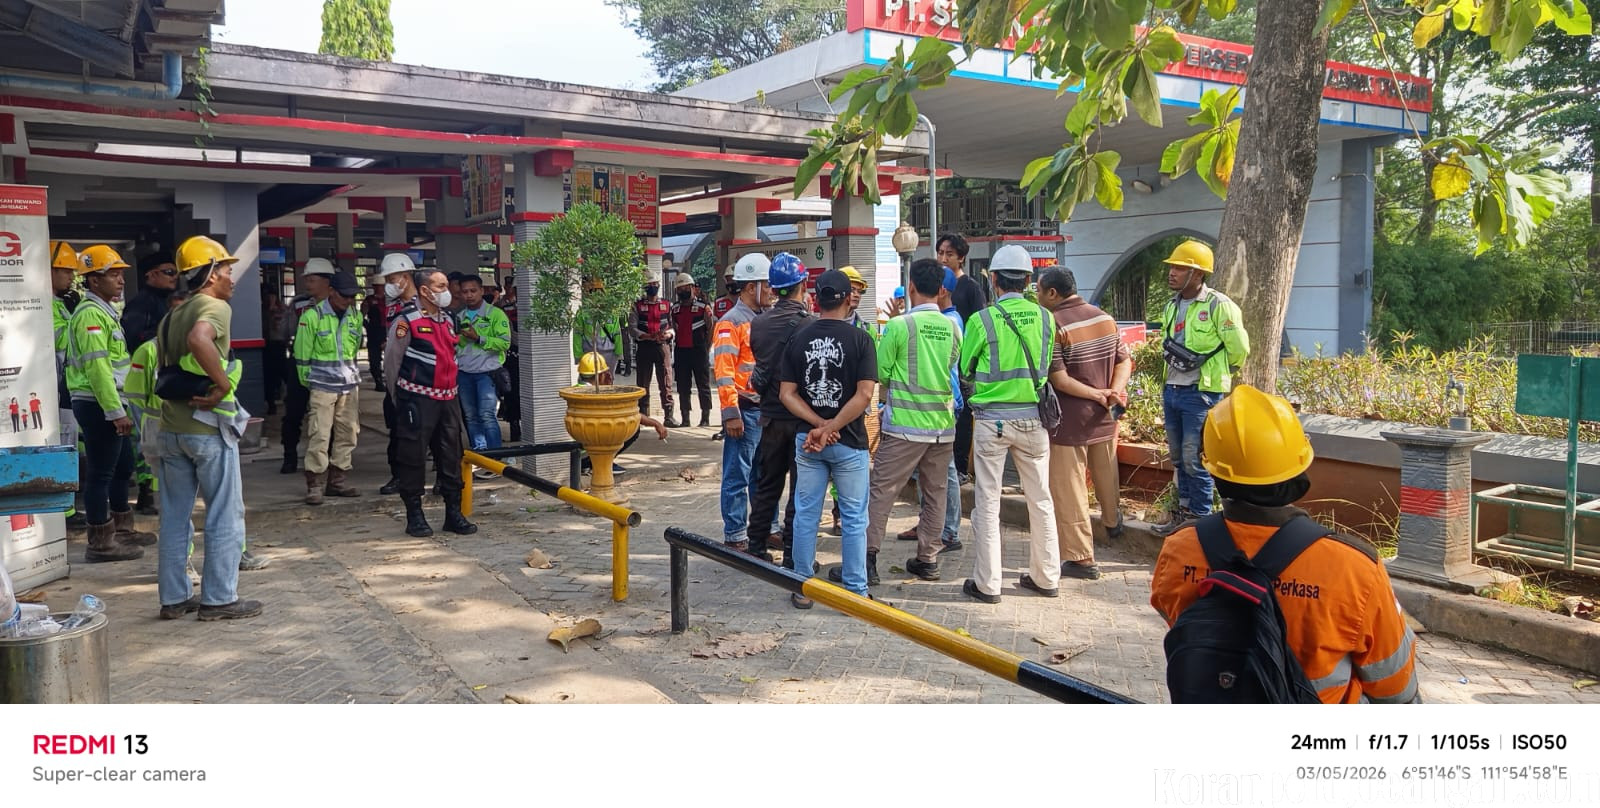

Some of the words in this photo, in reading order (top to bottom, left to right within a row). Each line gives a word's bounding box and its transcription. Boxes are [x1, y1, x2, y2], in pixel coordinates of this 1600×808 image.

[809, 336, 835, 350] TIDAK
[1183, 565, 1198, 584] PT.
[1273, 576, 1320, 599] Perkasa
